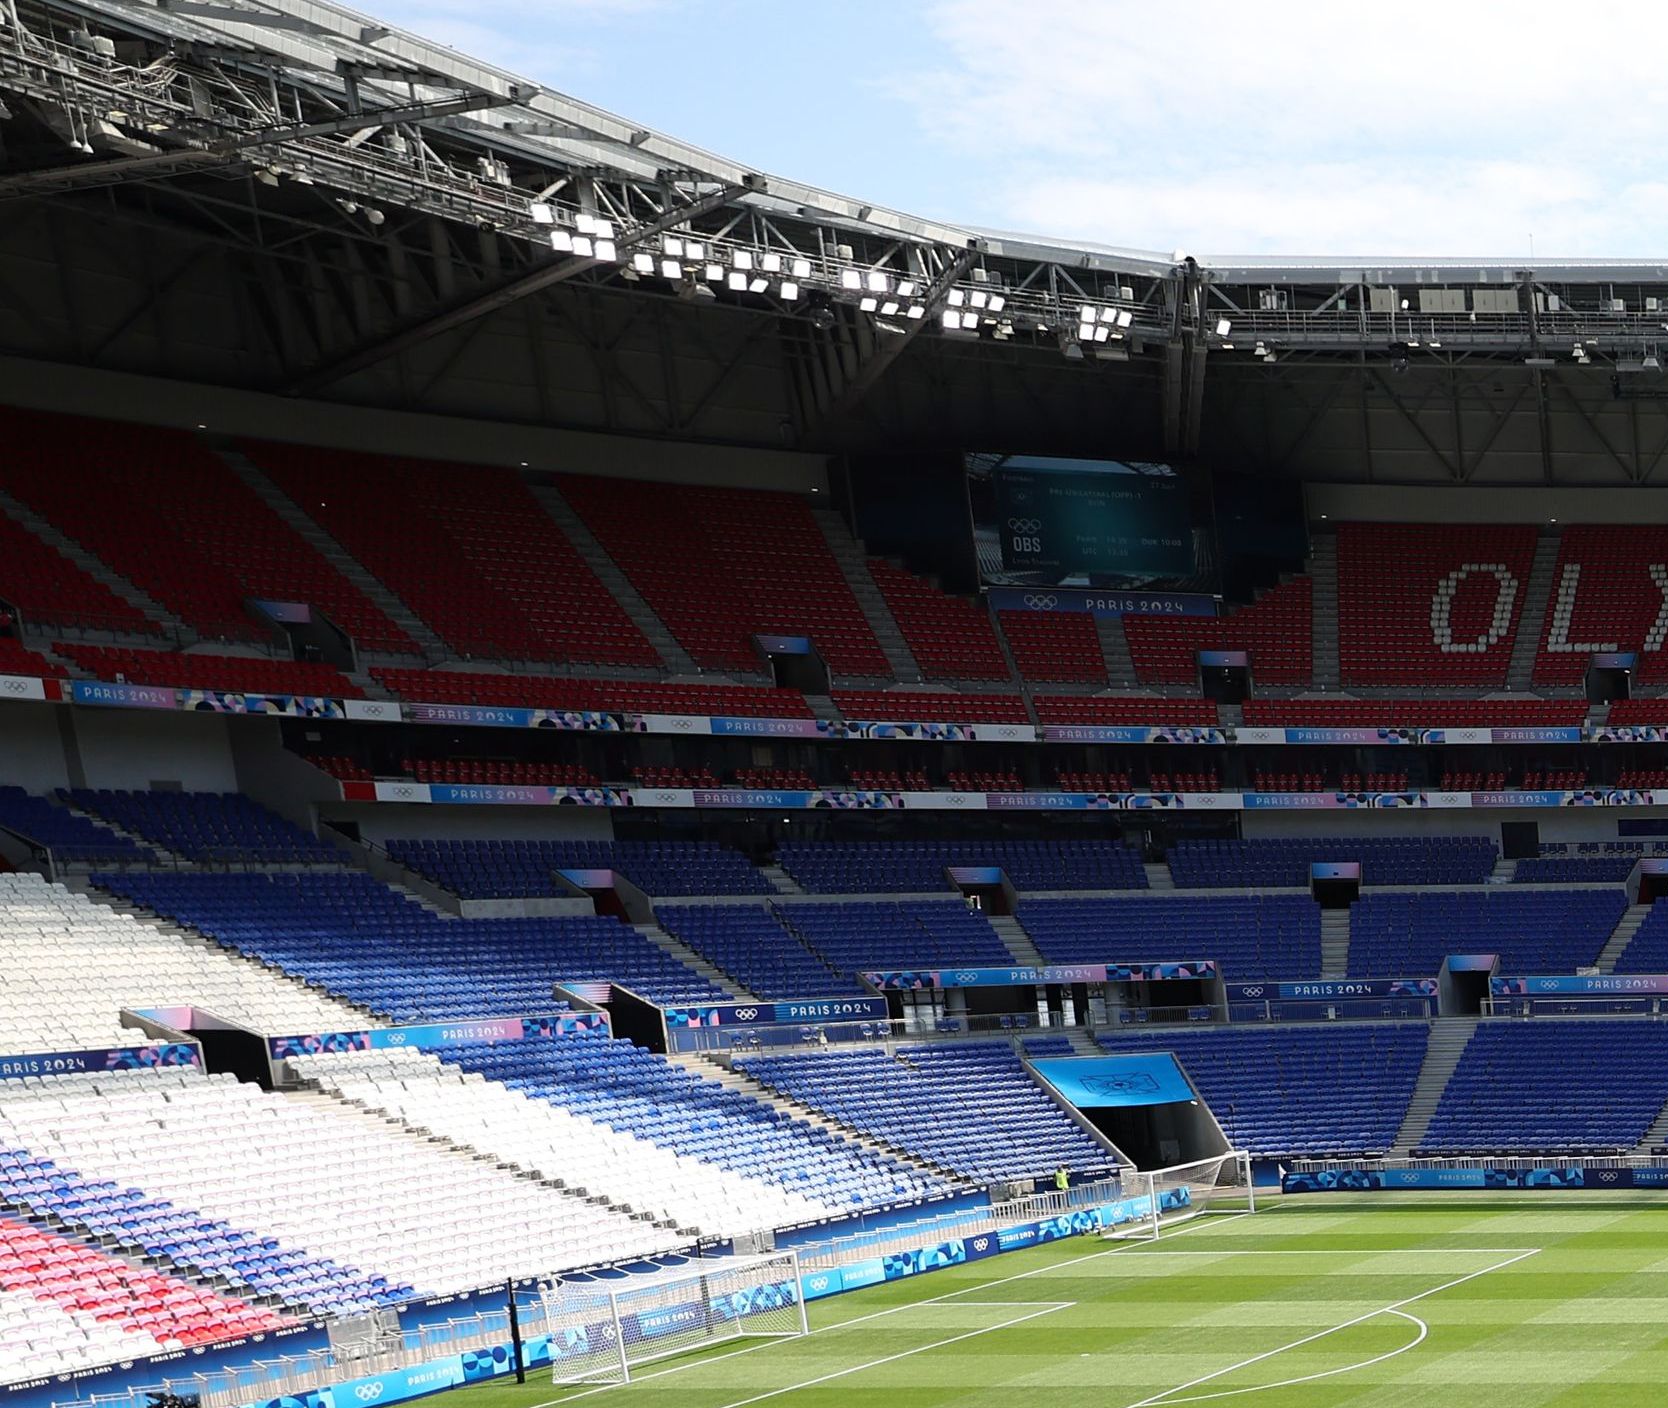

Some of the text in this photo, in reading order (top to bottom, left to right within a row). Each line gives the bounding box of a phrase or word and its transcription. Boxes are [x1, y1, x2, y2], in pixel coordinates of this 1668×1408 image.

[1012, 536, 1041, 552] OBS
[1085, 599, 1184, 612] PARIS 2024
[129, 688, 167, 701] 2024
[476, 711, 515, 723] 2024
[768, 723, 803, 732] 2024
[1098, 730, 1132, 739] 2024
[1333, 731, 1366, 740] 2024
[1535, 731, 1568, 740] 2024
[498, 789, 535, 800] 2024
[747, 794, 782, 804] 2024
[1517, 794, 1548, 803] 2024
[1040, 796, 1073, 806] 2024
[1292, 796, 1324, 805] 2024
[1010, 969, 1092, 980] PARIS 2024
[1587, 979, 1657, 989] PARIS 2024
[1294, 985, 1372, 994] PARIS 2024
[790, 1003, 871, 1016] PARIS 2024
[442, 1025, 505, 1039] PARIS 2024
[2, 1058, 86, 1074] ARIS 2024
